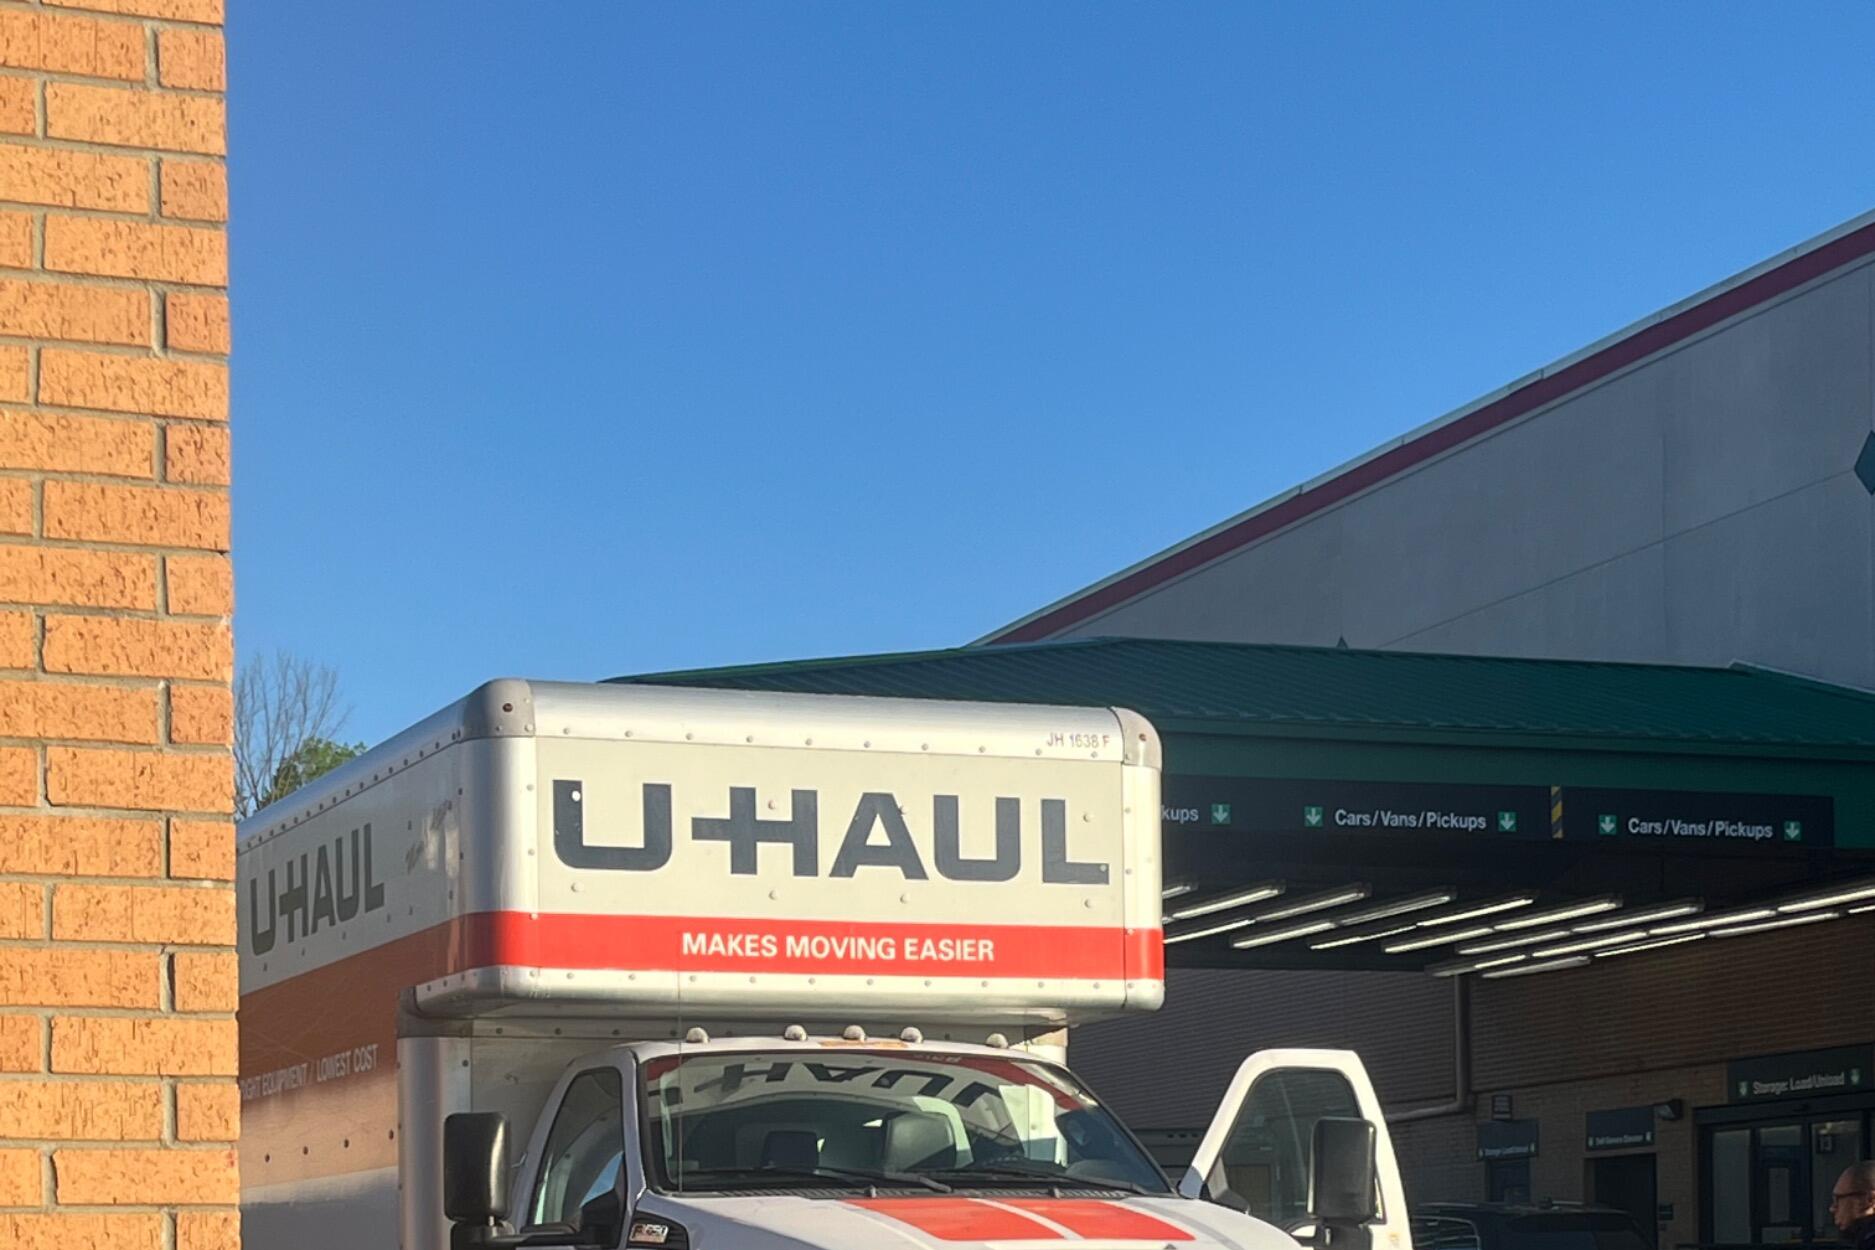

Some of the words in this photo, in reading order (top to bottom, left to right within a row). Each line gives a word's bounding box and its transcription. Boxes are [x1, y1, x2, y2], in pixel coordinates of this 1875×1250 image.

[1046, 732, 1064, 747] JH
[1069, 733, 1099, 749] 1638
[1102, 734, 1110, 748] F
[552, 779, 1110, 885] U-HAUL
[1334, 808, 1487, 831] Cars/Vans/Pickups
[1628, 817, 1773, 840] Cars/Vans/Pickups
[250, 823, 385, 956] U-HAUL
[682, 932, 777, 958] MAKES
[785, 936, 896, 960] MOVING
[904, 938, 995, 961] EASIER
[262, 1062, 308, 1097] EQUIPMENT
[316, 1050, 352, 1082] LOWEST
[353, 1043, 379, 1073] COST
